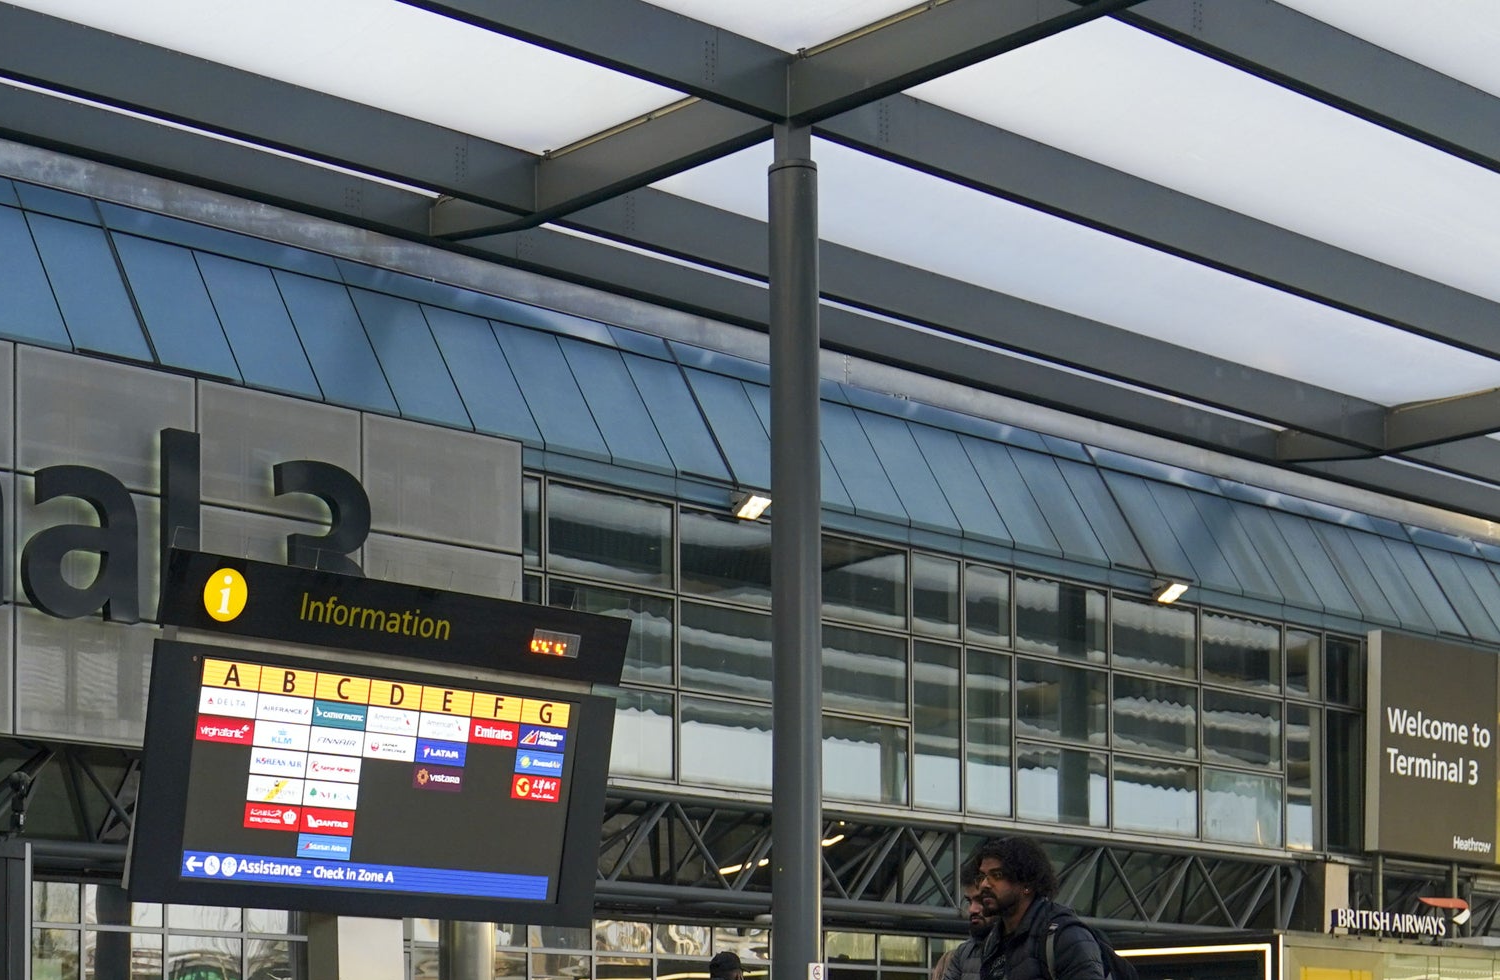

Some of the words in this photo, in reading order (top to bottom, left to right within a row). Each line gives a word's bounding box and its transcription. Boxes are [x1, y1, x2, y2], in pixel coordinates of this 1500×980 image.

[300, 592, 451, 641] Information
[224, 664, 241, 687] A
[282, 671, 296, 693] B
[337, 678, 351, 700] C
[390, 684, 404, 705] D
[217, 698, 246, 707] DELTA
[443, 691, 453, 712] E
[494, 697, 504, 717] F
[539, 703, 553, 724] G
[474, 725, 513, 741] Emirates
[1387, 706, 1468, 745] Welcome
[1472, 723, 1491, 748] to
[271, 736, 292, 745] KLM
[317, 736, 357, 747] FINNAIR
[430, 748, 459, 759] LATAM
[1387, 747, 1463, 783] Terminal
[1468, 760, 1479, 786] 3
[1453, 835, 1491, 853] Heathrow
[238, 859, 302, 877] Assistance
[313, 865, 344, 880] Check
[346, 868, 356, 880] in
[358, 870, 384, 883] Zone
[384, 871, 395, 883] A
[1337, 908, 1390, 931] BRITISH
[1392, 913, 1446, 937] AIRWAYS
